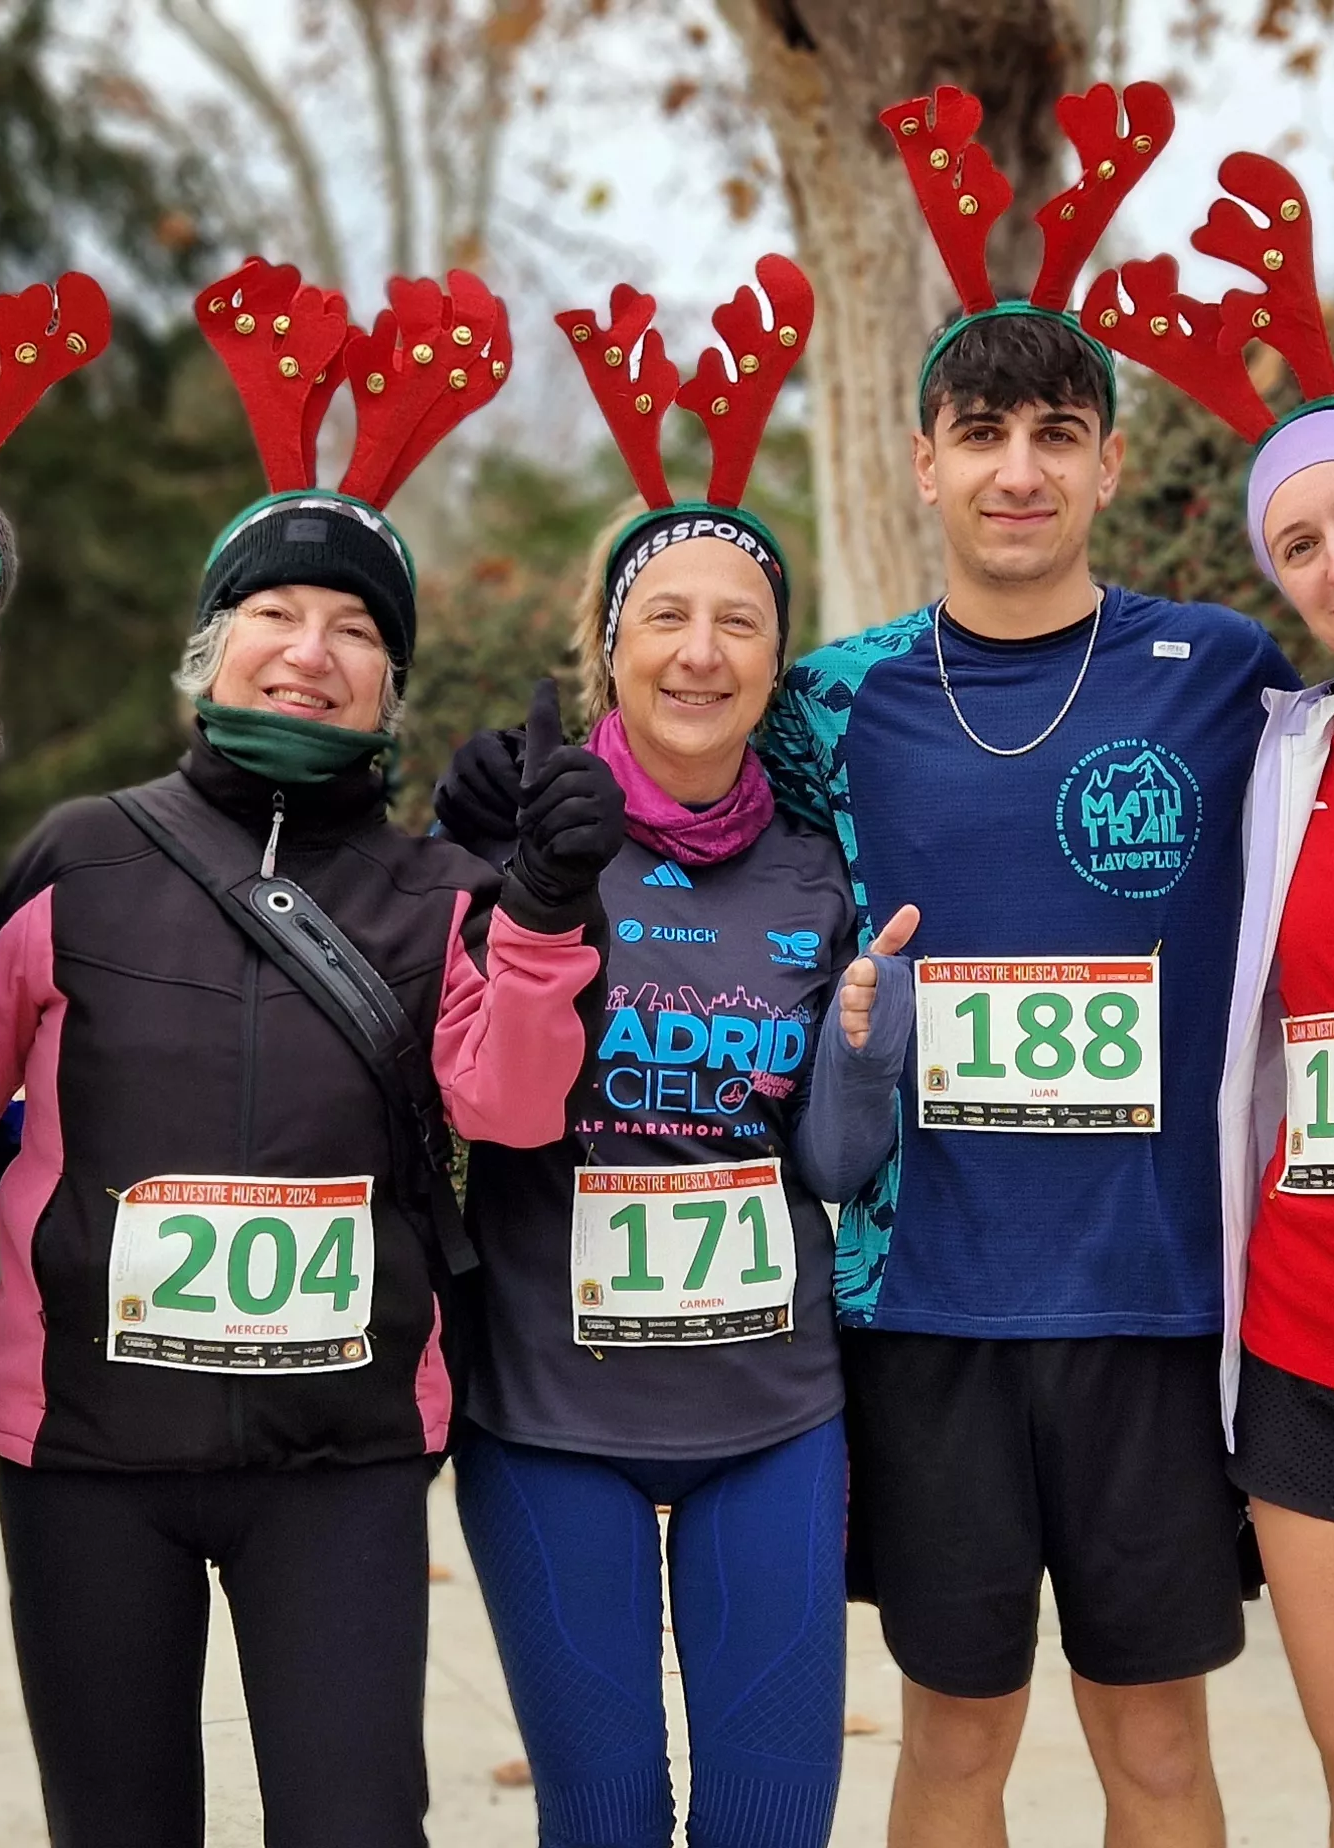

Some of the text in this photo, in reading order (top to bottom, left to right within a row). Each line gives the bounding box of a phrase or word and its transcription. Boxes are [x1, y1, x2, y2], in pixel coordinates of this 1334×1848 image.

[1078, 738, 1138, 767] DESDE 2014
[1155, 743, 1167, 755] EL
[1169, 751, 1200, 793] SECRETO
[1081, 789, 1183, 821] MATU
[1081, 813, 1186, 848] TRAIL
[1058, 834, 1073, 856] POR
[1070, 857, 1109, 892] MARCHA
[650, 926, 717, 943] ZURICH
[928, 965, 1091, 981] SAN SILVESTRE HUESCA 2024
[597, 1007, 806, 1074] ADRID
[955, 992, 1143, 1081] 188
[1292, 1024, 1306, 1041] SAN
[605, 1067, 752, 1115] CIELO
[1030, 1088, 1059, 1098] JUAN
[614, 1120, 724, 1137] MARATHON
[733, 1121, 767, 1138] 2024
[586, 1175, 608, 1191] SAN
[610, 1174, 666, 1191] SILVESTRE
[670, 1173, 712, 1190] HUESCA
[714, 1171, 734, 1188] 2024
[135, 1184, 160, 1202] SAN
[163, 1185, 229, 1203] SILVESTRE
[232, 1187, 282, 1204] HUESCA
[286, 1187, 317, 1205] 2024
[610, 1195, 782, 1291] 171
[152, 1214, 359, 1316] 204
[679, 1298, 725, 1310] CARMEN
[224, 1324, 289, 1336] MERCEDES
